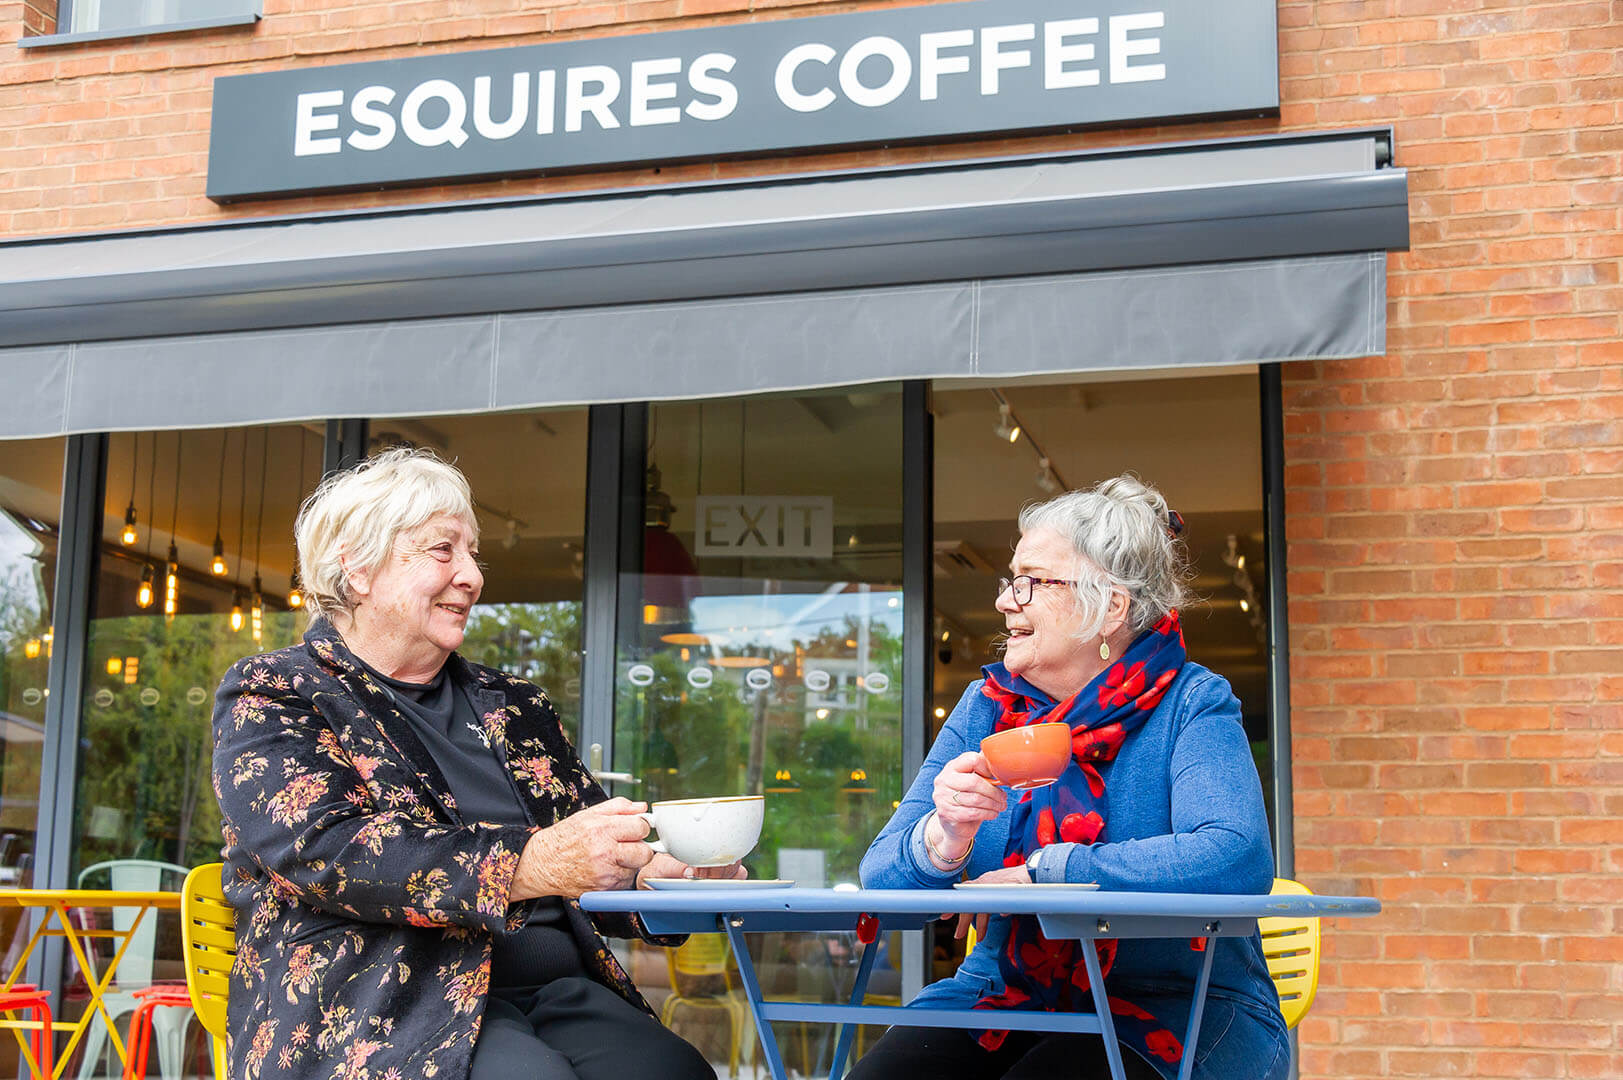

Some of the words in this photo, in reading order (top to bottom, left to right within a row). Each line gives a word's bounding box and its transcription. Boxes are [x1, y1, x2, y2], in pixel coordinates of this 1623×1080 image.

[294, 53, 738, 157] ESQUIRES
[775, 11, 1167, 113] COFFEE
[704, 505, 823, 547] EXIT
